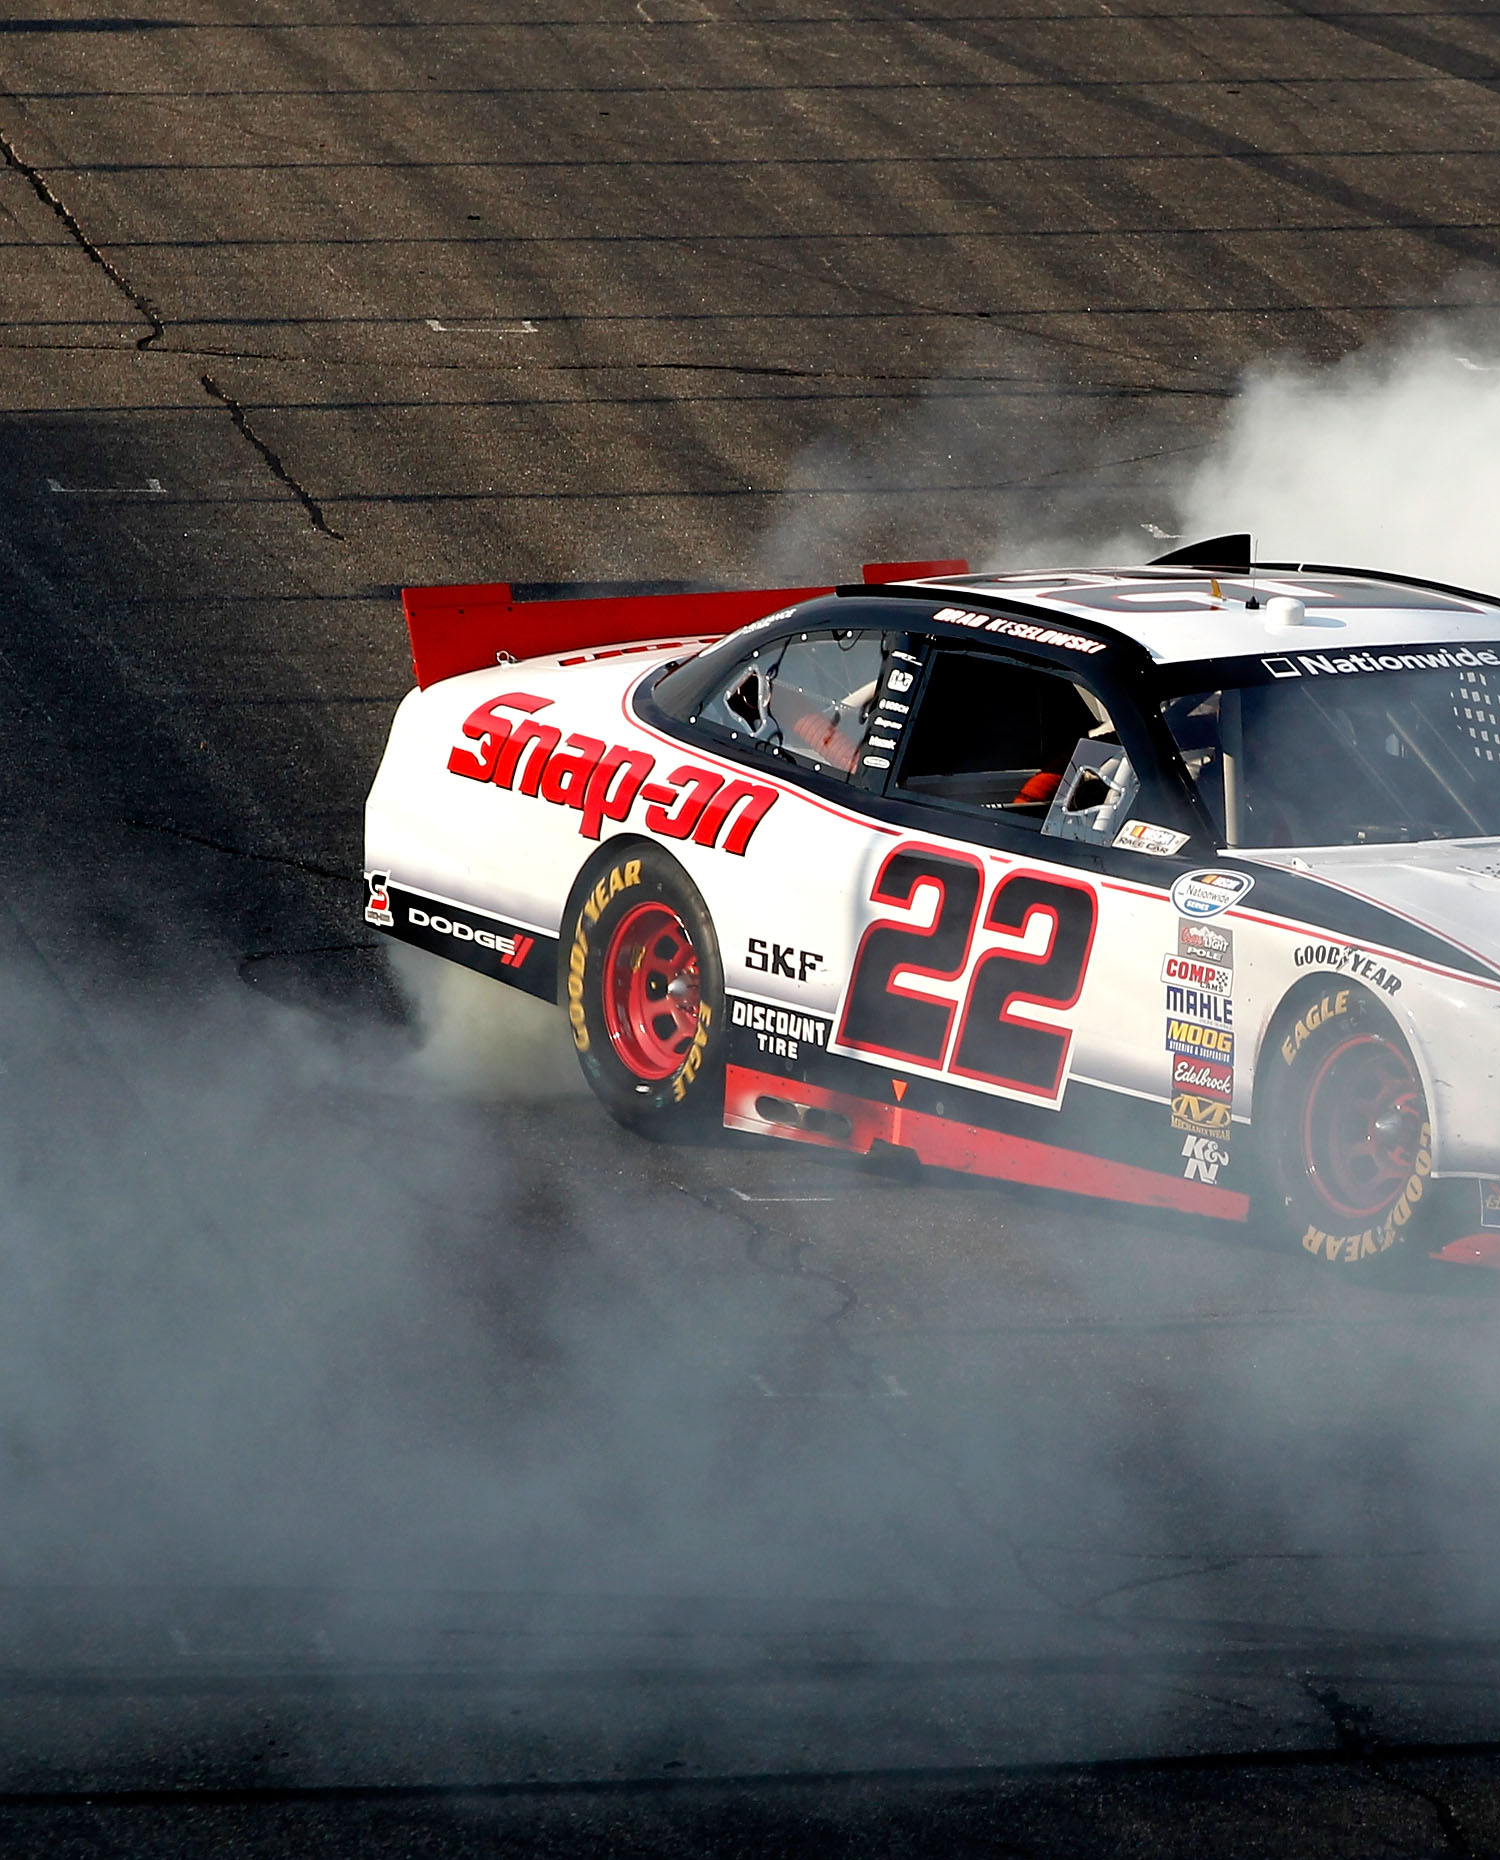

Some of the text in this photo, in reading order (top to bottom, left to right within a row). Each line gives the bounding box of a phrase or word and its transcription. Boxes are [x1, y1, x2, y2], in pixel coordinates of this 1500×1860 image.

[932, 607, 1107, 654] BRAD KESELOWSKI
[1298, 647, 1500, 675] Nationwide
[1118, 836, 1170, 854] RACE CAR
[1185, 884, 1230, 905] Nationwide
[408, 908, 516, 956] DODGE
[1203, 936, 1230, 953] LIGHT
[745, 938, 824, 982] SKF
[1187, 946, 1223, 961] POLE
[835, 840, 1098, 1101] 22
[1166, 959, 1216, 985] COMP
[1200, 981, 1224, 993] CAMS
[1294, 945, 1403, 996] GOODYEAR
[1166, 985, 1233, 1025] MAHLE
[732, 1000, 826, 1047] DISCOUNT
[1168, 1020, 1233, 1053] MOOG
[1281, 989, 1350, 1066] EAGLE
[672, 1000, 712, 1102] EAGLE
[757, 1032, 799, 1060] TIRE
[1174, 1061, 1232, 1094] Edelbrock
